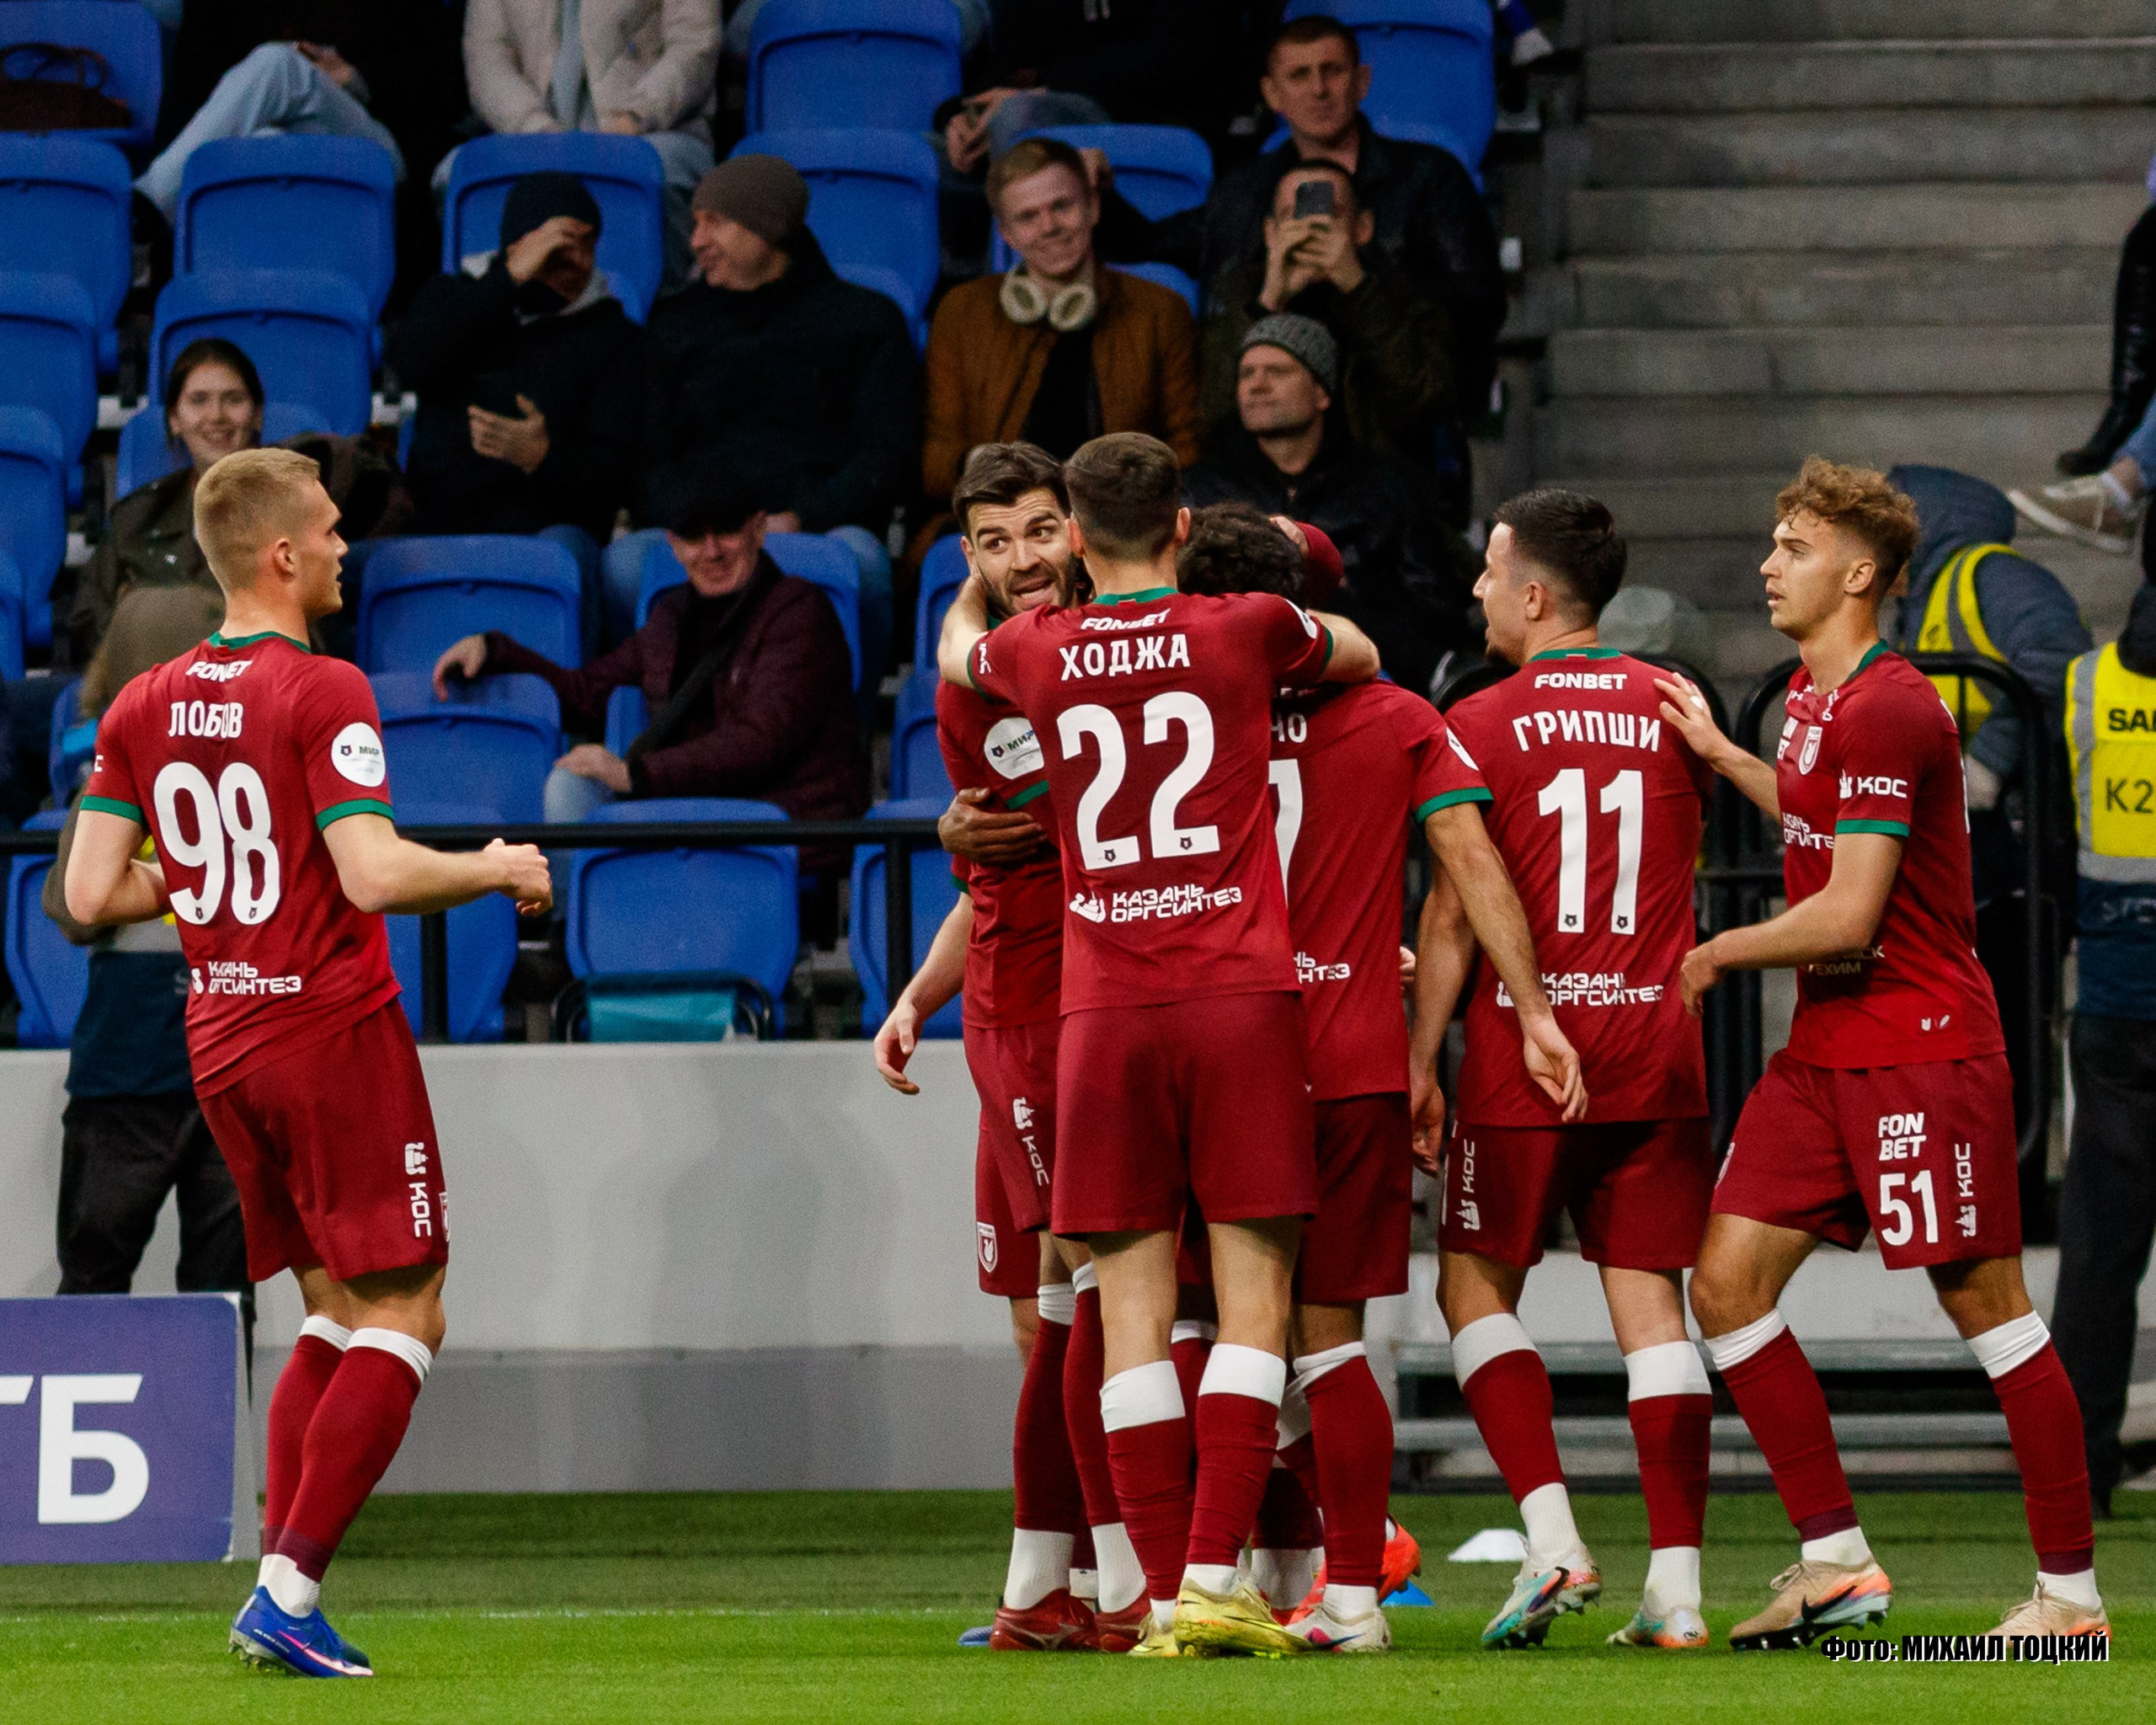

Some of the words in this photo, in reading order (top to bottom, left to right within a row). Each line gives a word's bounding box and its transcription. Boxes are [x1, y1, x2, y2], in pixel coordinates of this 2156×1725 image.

[185, 660, 253, 682] FONET
[1059, 633, 1190, 681] ХОДЖА
[1534, 672, 1627, 690] FONBET
[1512, 710, 1661, 752] ГРИПШИ
[2108, 708, 2156, 732] SA
[1057, 692, 1219, 871] 22
[153, 761, 280, 925] 98
[1538, 768, 1643, 935] 11
[1111, 887, 1242, 923] ОРГСИНТЕЗ
[1113, 884, 1204, 908] КАЗАНЬ
[1878, 1112, 1924, 1138] FON
[1878, 1135, 1927, 1161] BET
[1880, 1170, 1939, 1246] 51
